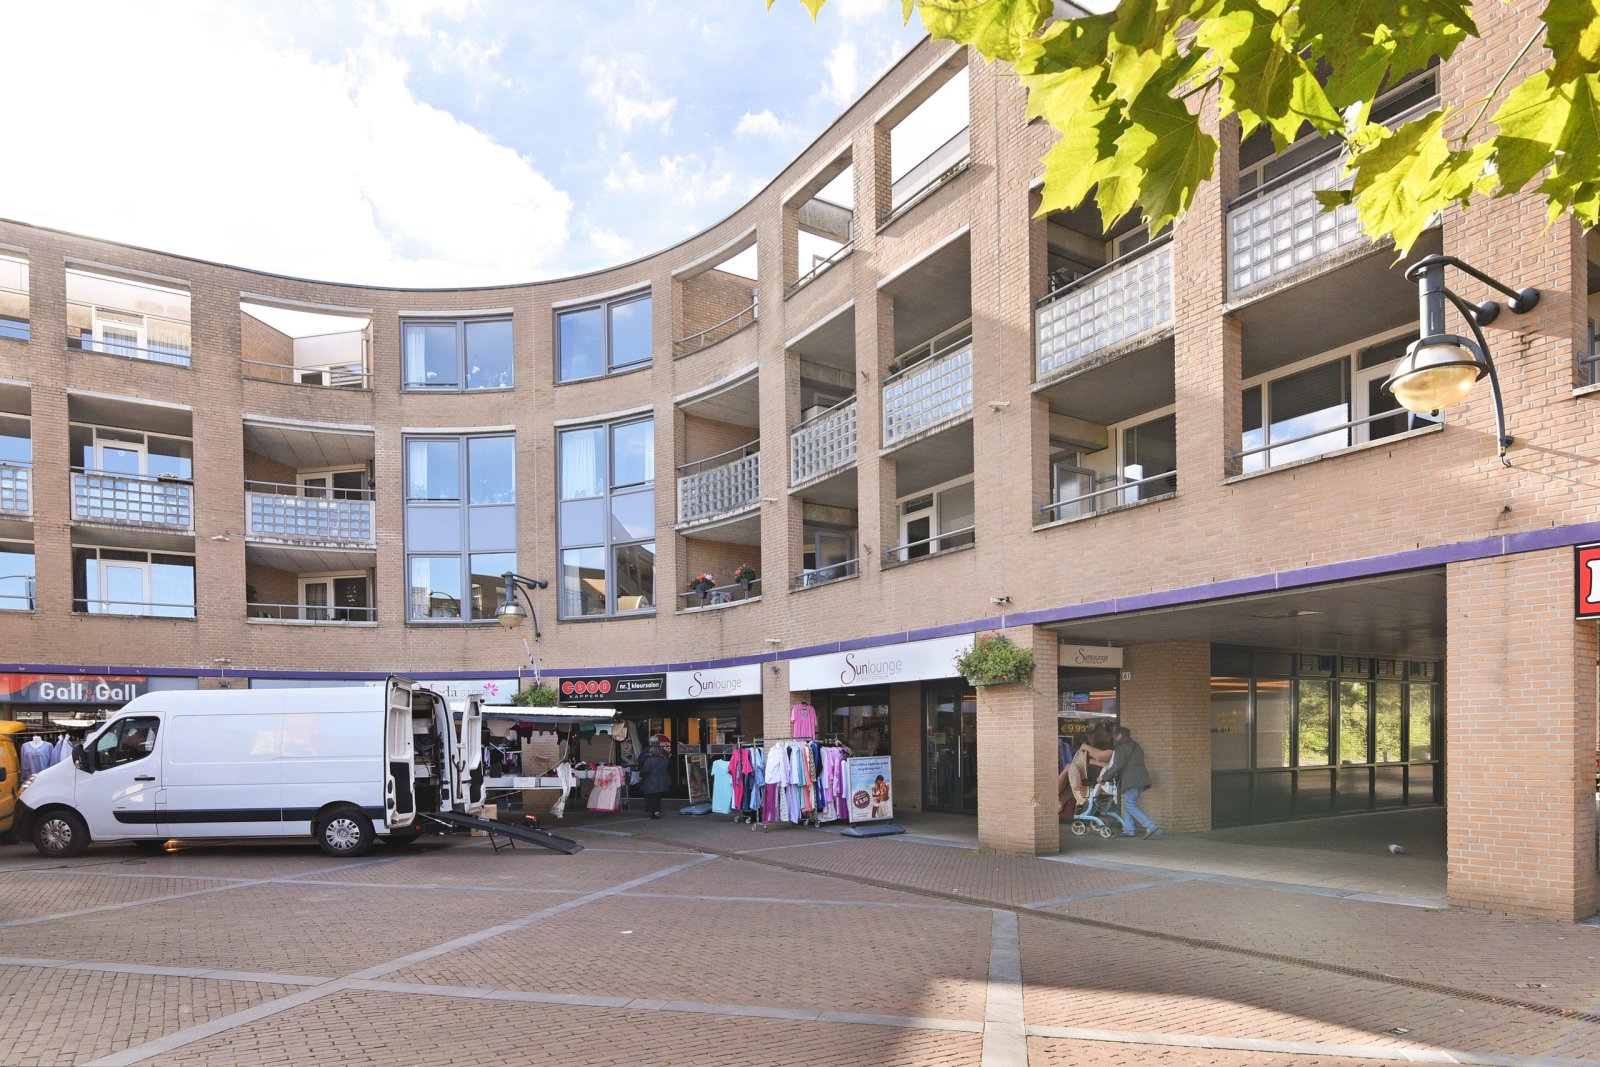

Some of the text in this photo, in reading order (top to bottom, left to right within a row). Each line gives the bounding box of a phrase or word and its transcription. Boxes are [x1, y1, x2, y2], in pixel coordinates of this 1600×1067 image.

[1075, 648, 1109, 665] Sunlounge
[840, 652, 903, 685] Sunlounge
[1122, 672, 1131, 680] 61
[40, 682, 83, 701] Gall
[95, 683, 136, 701] Gall
[631, 681, 660, 689] kleursalon
[688, 671, 742, 698] Sunlounge
